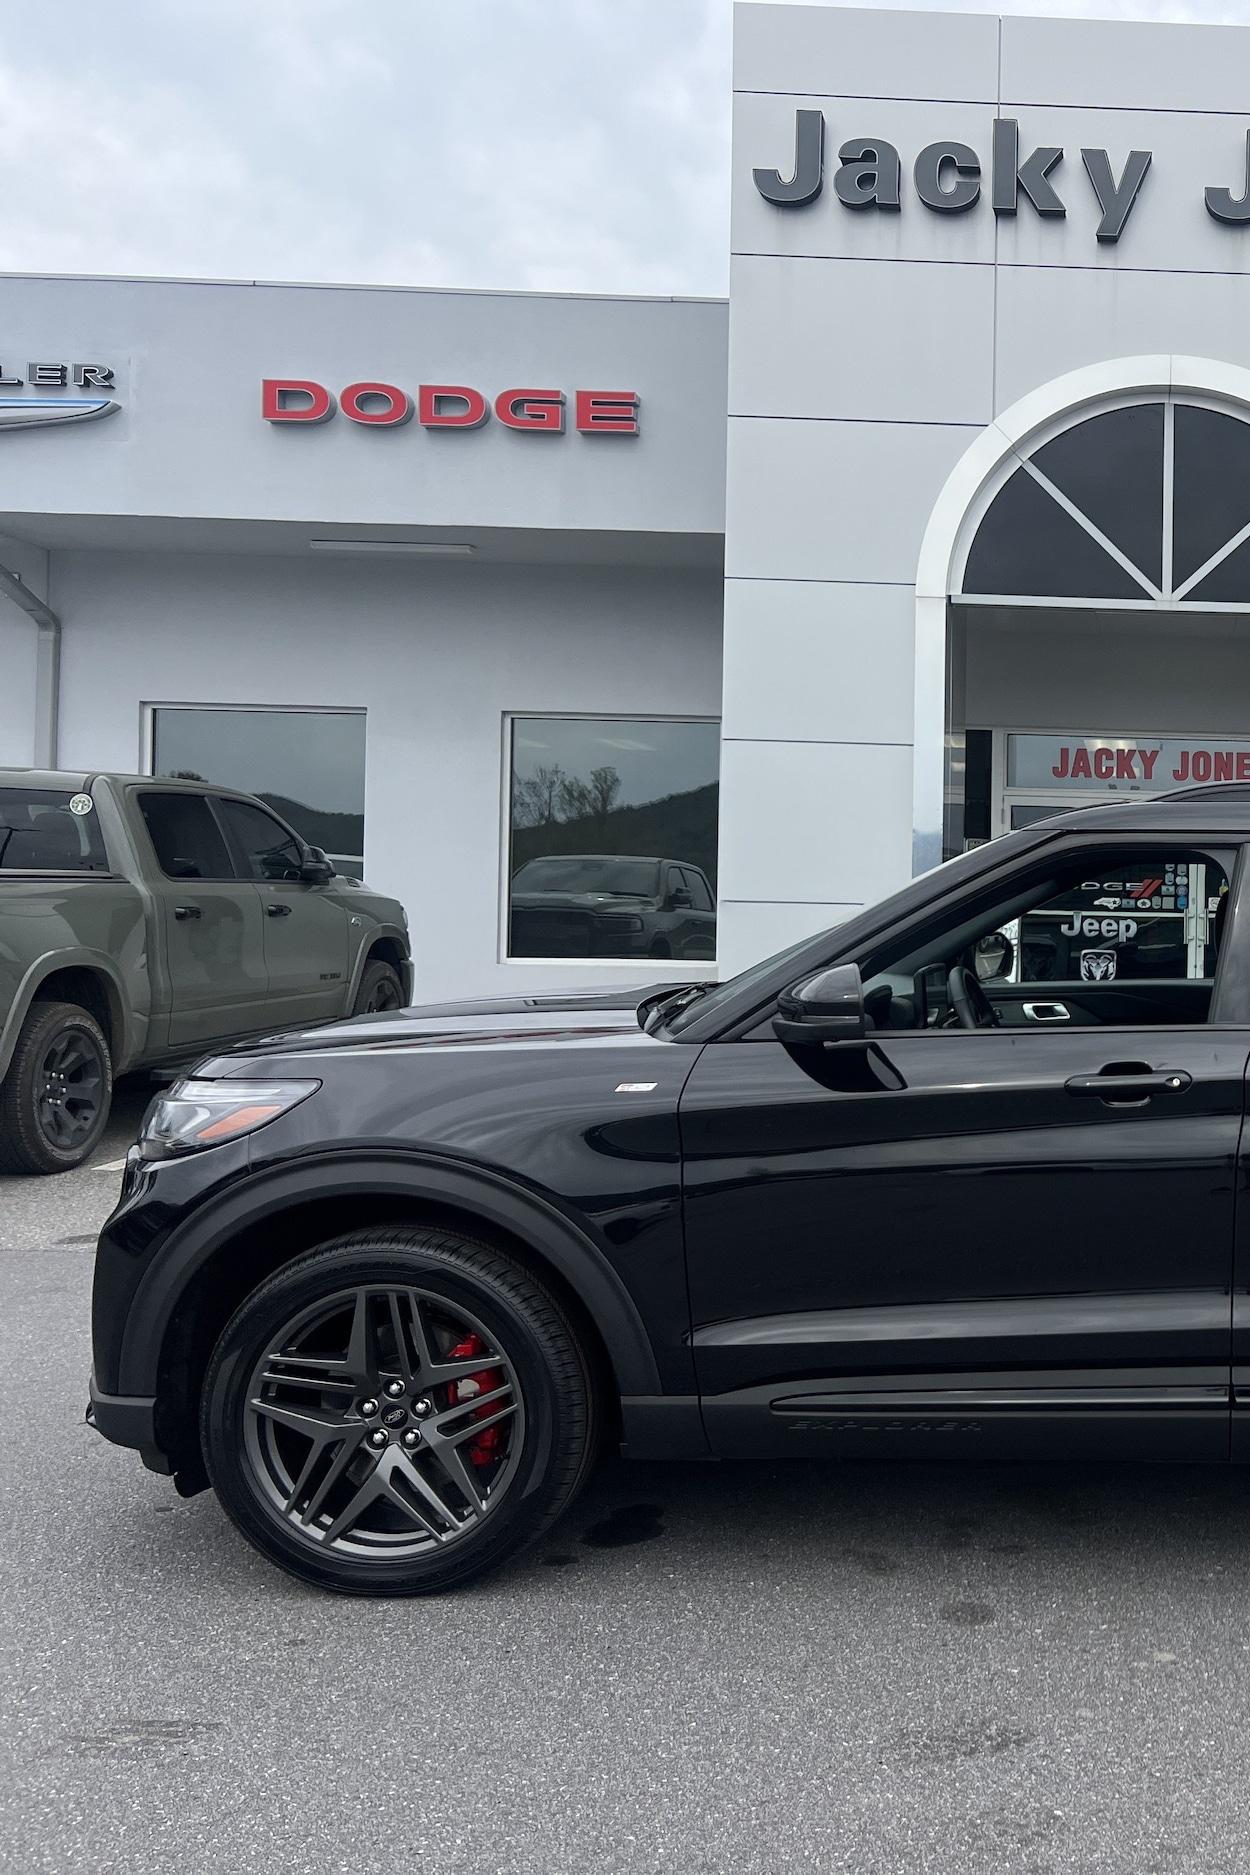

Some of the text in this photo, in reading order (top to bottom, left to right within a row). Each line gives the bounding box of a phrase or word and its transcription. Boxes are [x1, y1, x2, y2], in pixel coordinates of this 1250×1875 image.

[753, 109, 1152, 244] Jacky
[262, 379, 640, 437] DODGE
[1052, 747, 1160, 780] JACKY
[1061, 912, 1138, 943] Jeep
